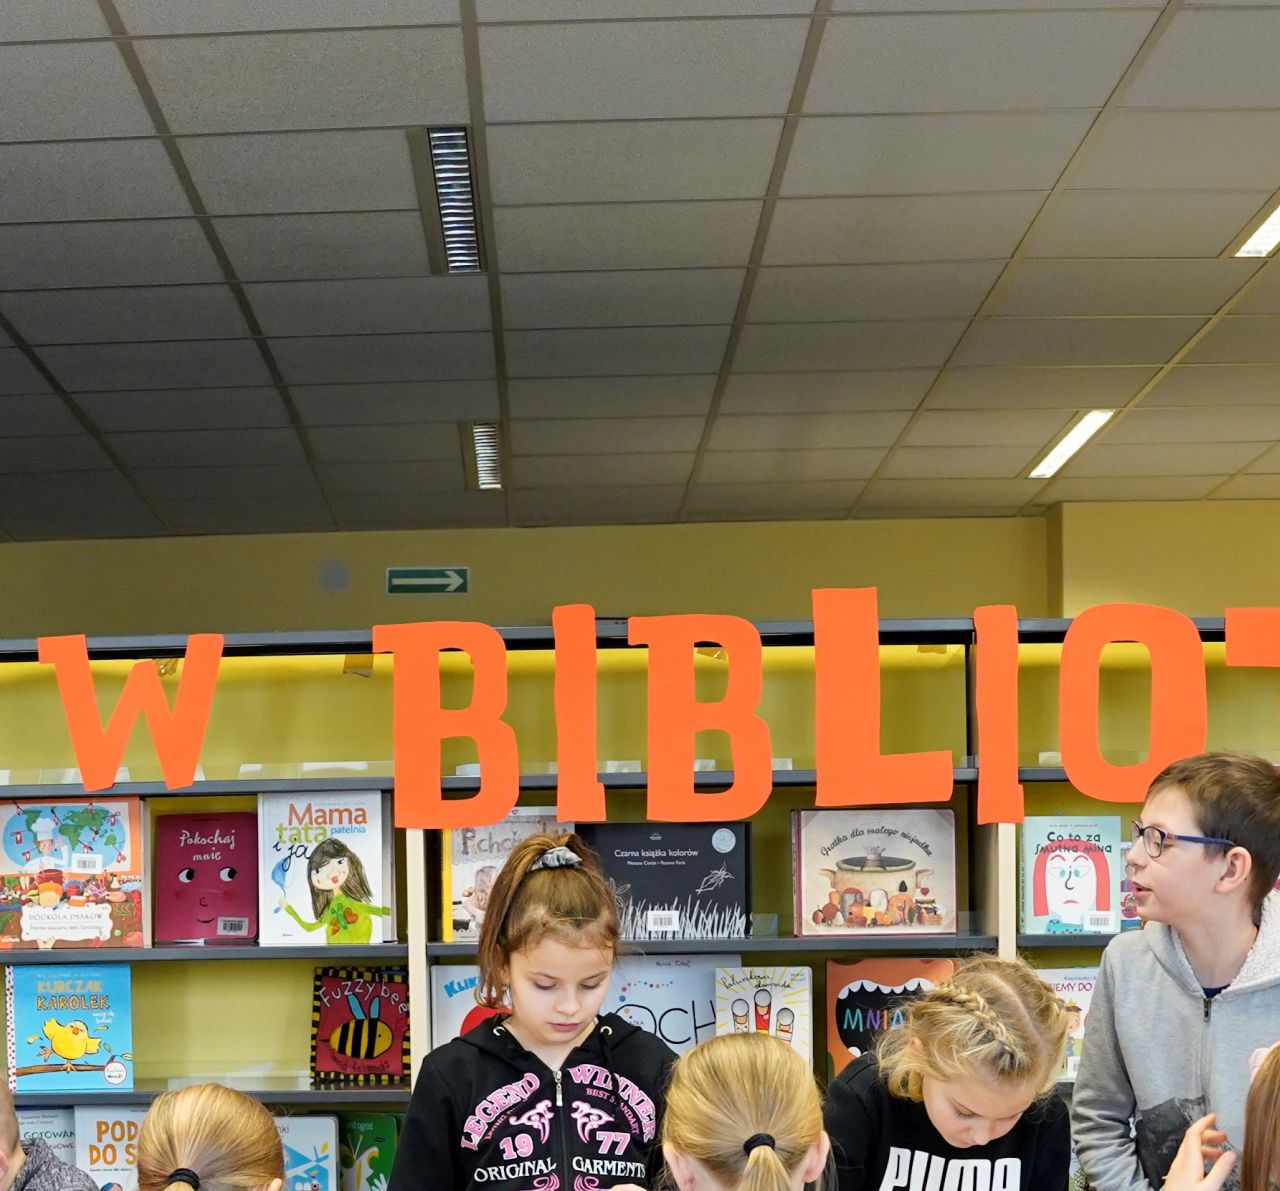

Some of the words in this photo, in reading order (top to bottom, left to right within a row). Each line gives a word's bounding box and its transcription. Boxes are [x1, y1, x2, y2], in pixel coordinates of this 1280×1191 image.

[287, 803, 368, 826] Mama
[179, 829, 236, 849] Pokochaj
[275, 822, 328, 845] tata
[330, 824, 367, 835] patelnia
[820, 836, 848, 857] Gratka
[850, 828, 865, 839] dla
[1047, 831, 1066, 842] Co
[1068, 832, 1081, 842] to
[1086, 833, 1101, 842] za
[192, 848, 222, 861] mnie
[614, 849, 640, 857] Czarna
[641, 849, 667, 858] książka
[668, 848, 699, 857] kolorów
[319, 978, 376, 1008] Fuzzy
[380, 977, 408, 1015] bee
[1054, 982, 1077, 992] EMY
[1078, 982, 1093, 992] DO
[36, 994, 110, 1011] KAROLEK
[842, 1007, 908, 1032] MNIA
[586, 1087, 608, 1100] BEST
[461, 1072, 540, 1151] LEGEND
[23, 1130, 76, 1140] GOTOWAN
[96, 1120, 139, 1143] POD
[87, 1143, 118, 1166] DO
[124, 1143, 138, 1166] S
[499, 1133, 534, 1160] 19
[596, 1131, 631, 1156] 77
[473, 1156, 557, 1183] ORIGINAL
[572, 1155, 646, 1179] GARMENTS
